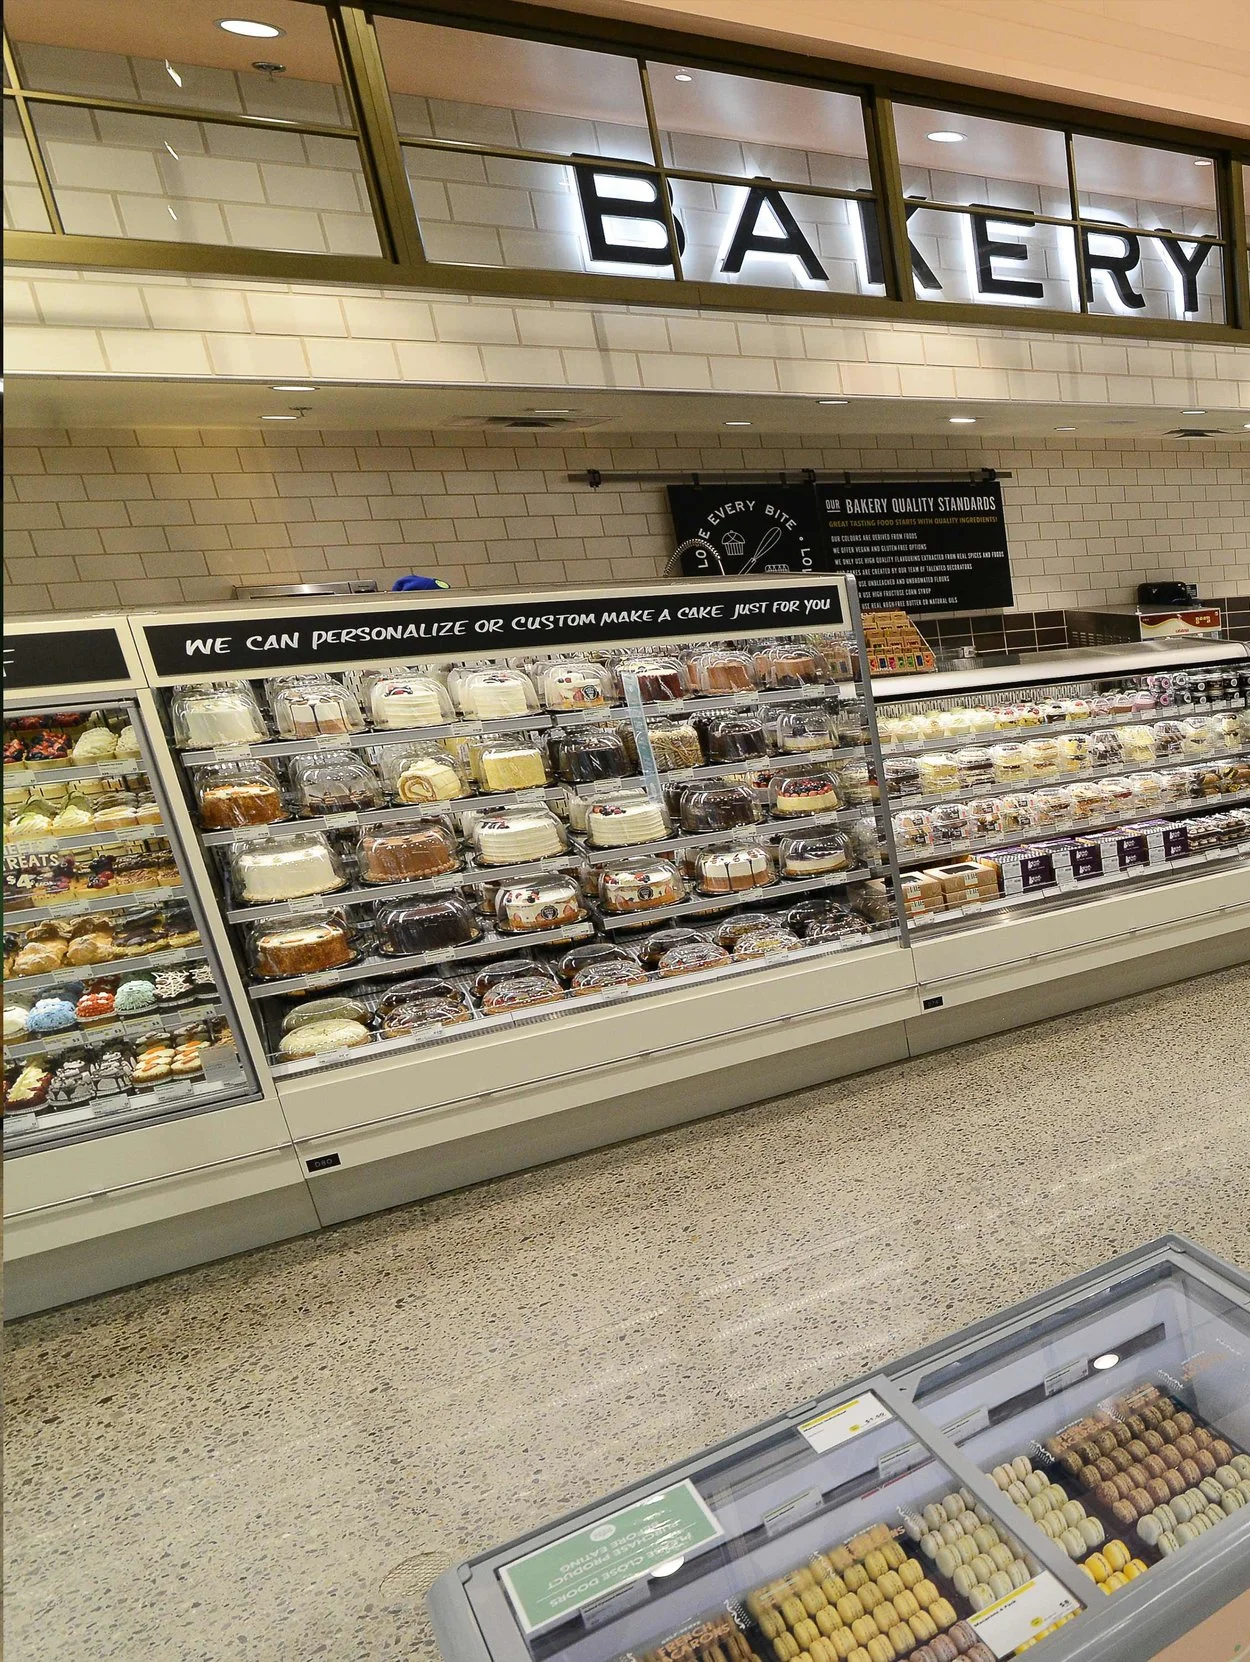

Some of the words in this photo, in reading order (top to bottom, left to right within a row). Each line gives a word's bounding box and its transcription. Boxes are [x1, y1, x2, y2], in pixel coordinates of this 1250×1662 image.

[569, 152, 1217, 313] BAKERY
[826, 499, 840, 509] OUR
[846, 498, 887, 514] BAKERY
[892, 497, 934, 513] QUALITY
[938, 496, 996, 512] STANDARDS
[959, 516, 998, 524] INGREDIENTS!
[695, 528, 710, 568] LOE
[707, 500, 755, 525] EVERY
[765, 505, 797, 530] BITE
[876, 556, 894, 564] QUALITY
[926, 564, 946, 572] TALENTED
[185, 637, 233, 656] WE
[246, 632, 300, 651] CAN
[312, 620, 467, 649] PERSONALIZE
[474, 618, 504, 633] OR
[511, 612, 597, 631] CUSTOM
[601, 609, 653, 627] MAKE
[657, 608, 671, 622] A
[677, 604, 724, 619] CAKE
[732, 602, 768, 620] JUST
[772, 600, 800, 613] FOR
[804, 598, 831, 614] YOU
[549, 1554, 611, 1590] PRODUCT
[560, 1545, 608, 1572] EATING
[602, 1557, 644, 1577] CLOSE
[550, 1577, 599, 1607] DOORS
